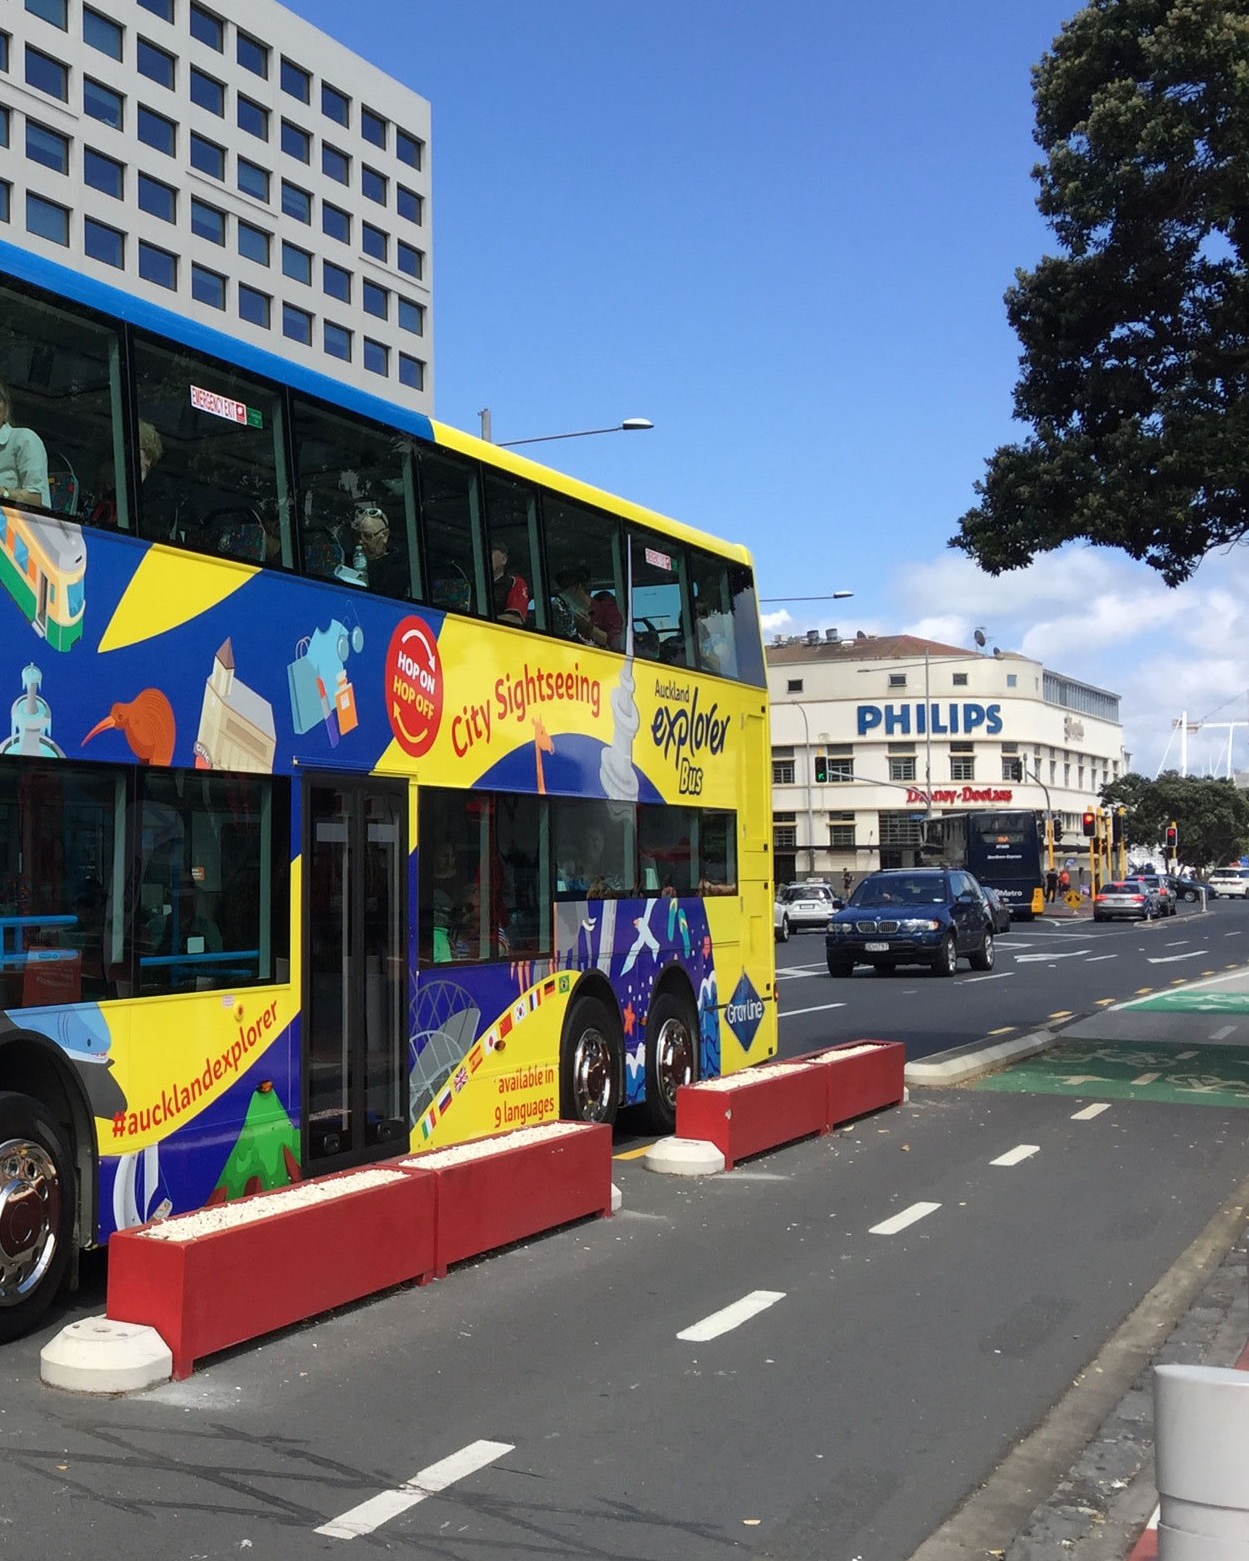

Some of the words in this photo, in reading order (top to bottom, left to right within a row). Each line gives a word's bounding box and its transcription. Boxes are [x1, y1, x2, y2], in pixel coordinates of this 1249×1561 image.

[397, 650, 420, 680] HOP
[420, 669, 436, 695] ON
[654, 678, 690, 704] Auckland
[393, 674, 415, 704] HOP
[415, 694, 435, 720] OFF
[451, 699, 491, 758] City
[494, 662, 601, 722] Sightseeing
[651, 686, 731, 771] explorer
[856, 703, 1004, 736] PHILIPS
[678, 757, 704, 796] Bus
[112, 1000, 277, 1138] #aucklandexplorer
[498, 1064, 543, 1094] available
[545, 1063, 554, 1084] in
[494, 1106, 502, 1129] 9
[504, 1097, 555, 1126] languages
